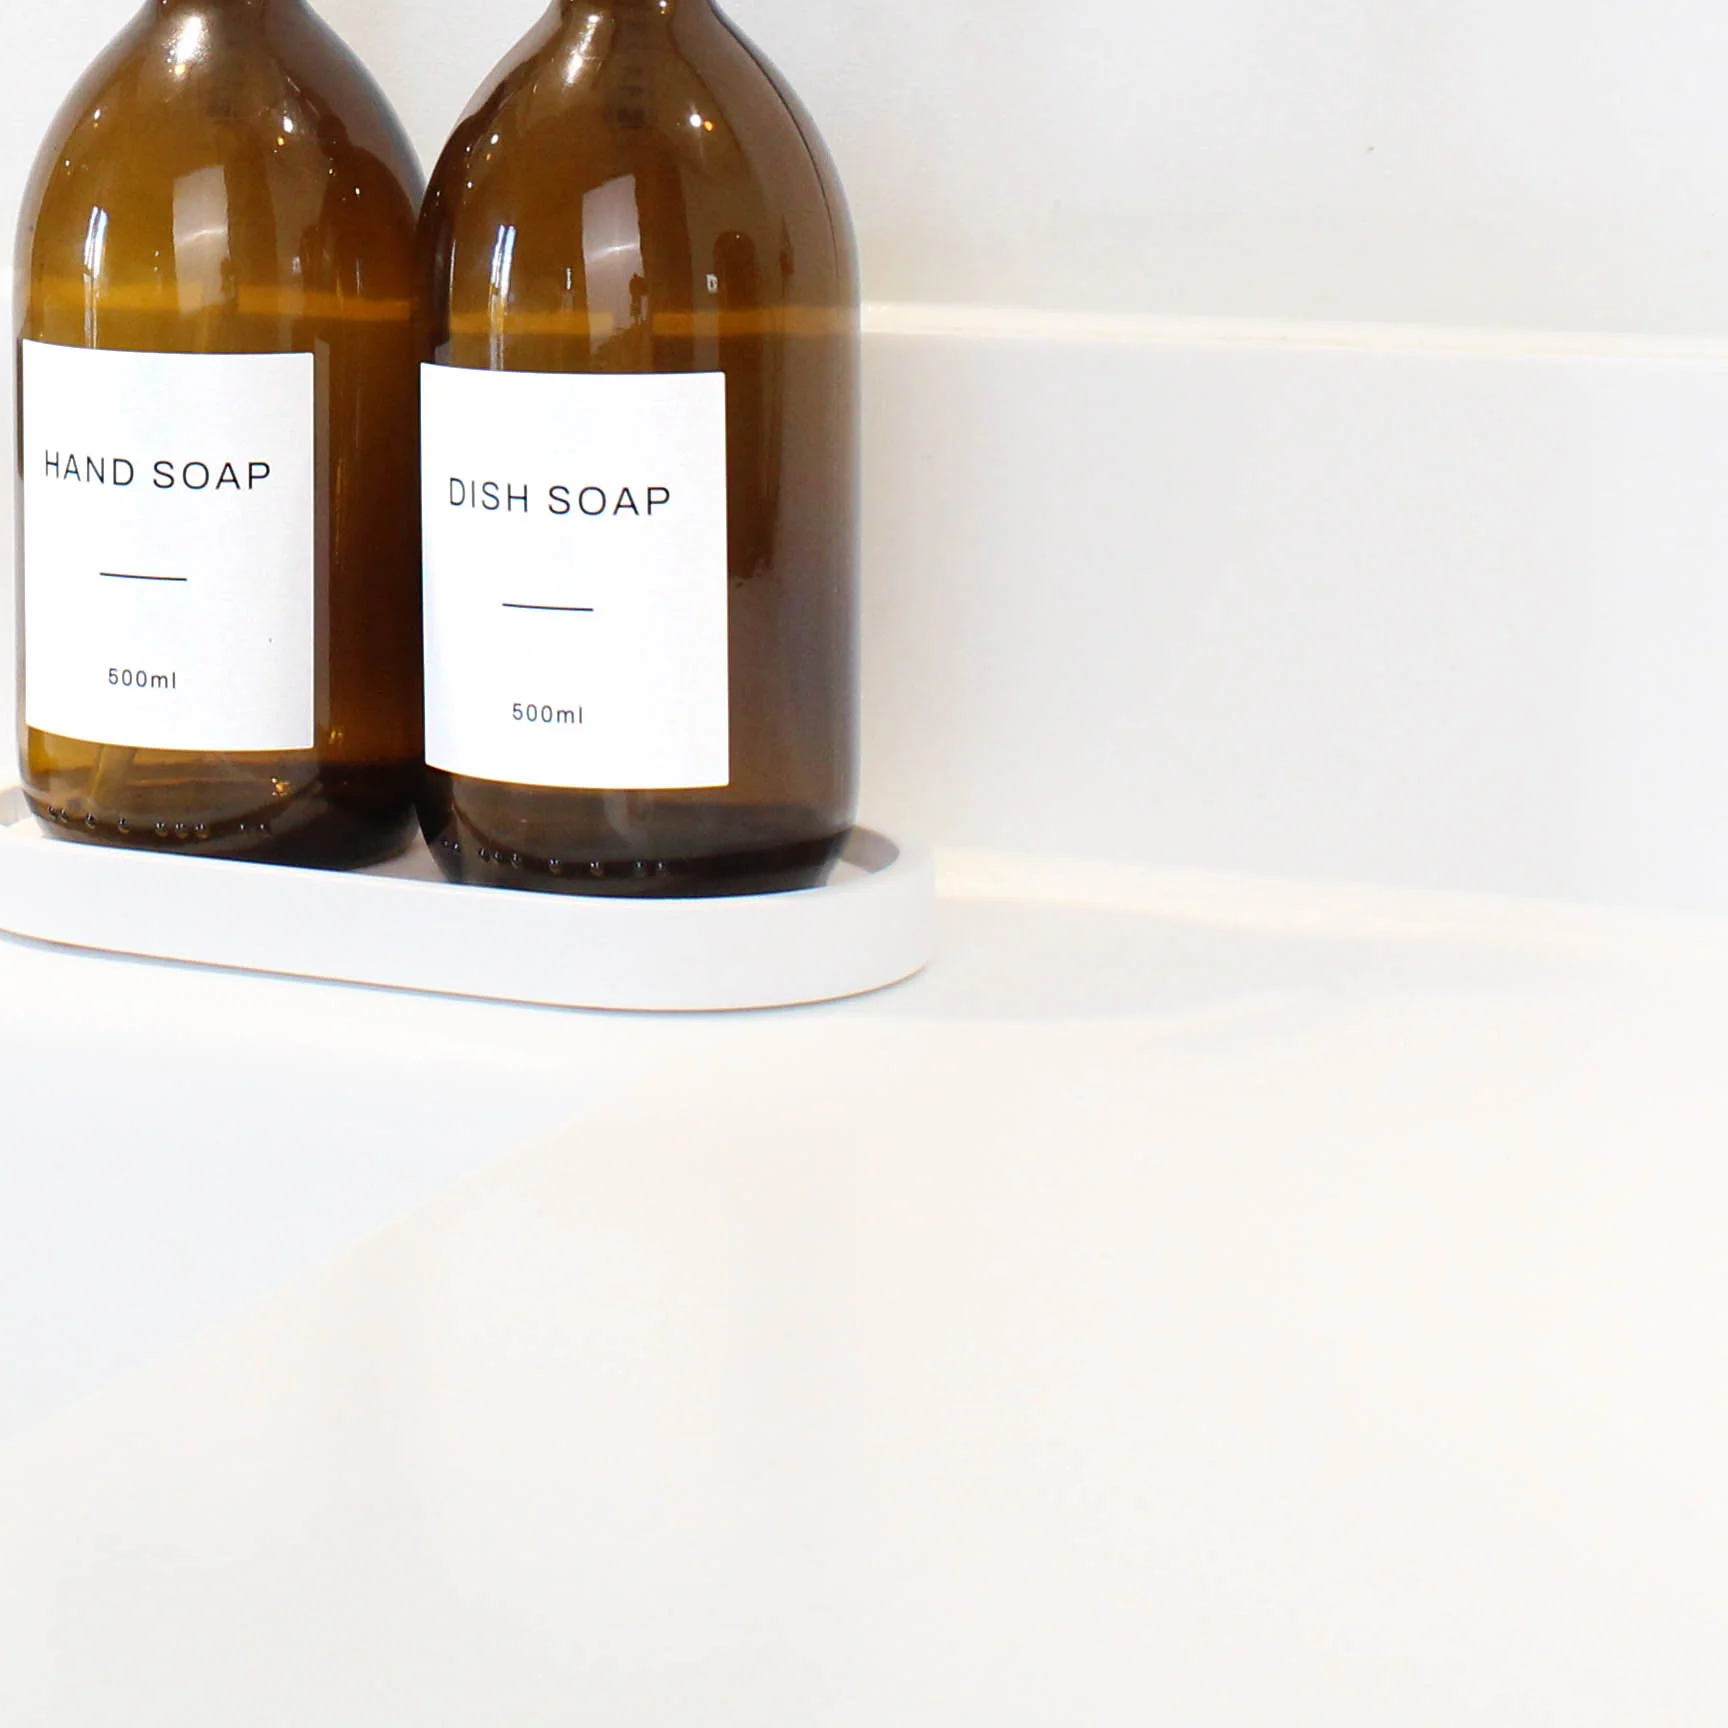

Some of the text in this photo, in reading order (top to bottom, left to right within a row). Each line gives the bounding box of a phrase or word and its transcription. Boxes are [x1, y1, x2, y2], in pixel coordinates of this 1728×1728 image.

[44, 450, 271, 490] HAND SOAP
[449, 477, 670, 516] DISH SOAP
[108, 668, 177, 689] 500ml
[512, 702, 584, 724] 500ml
